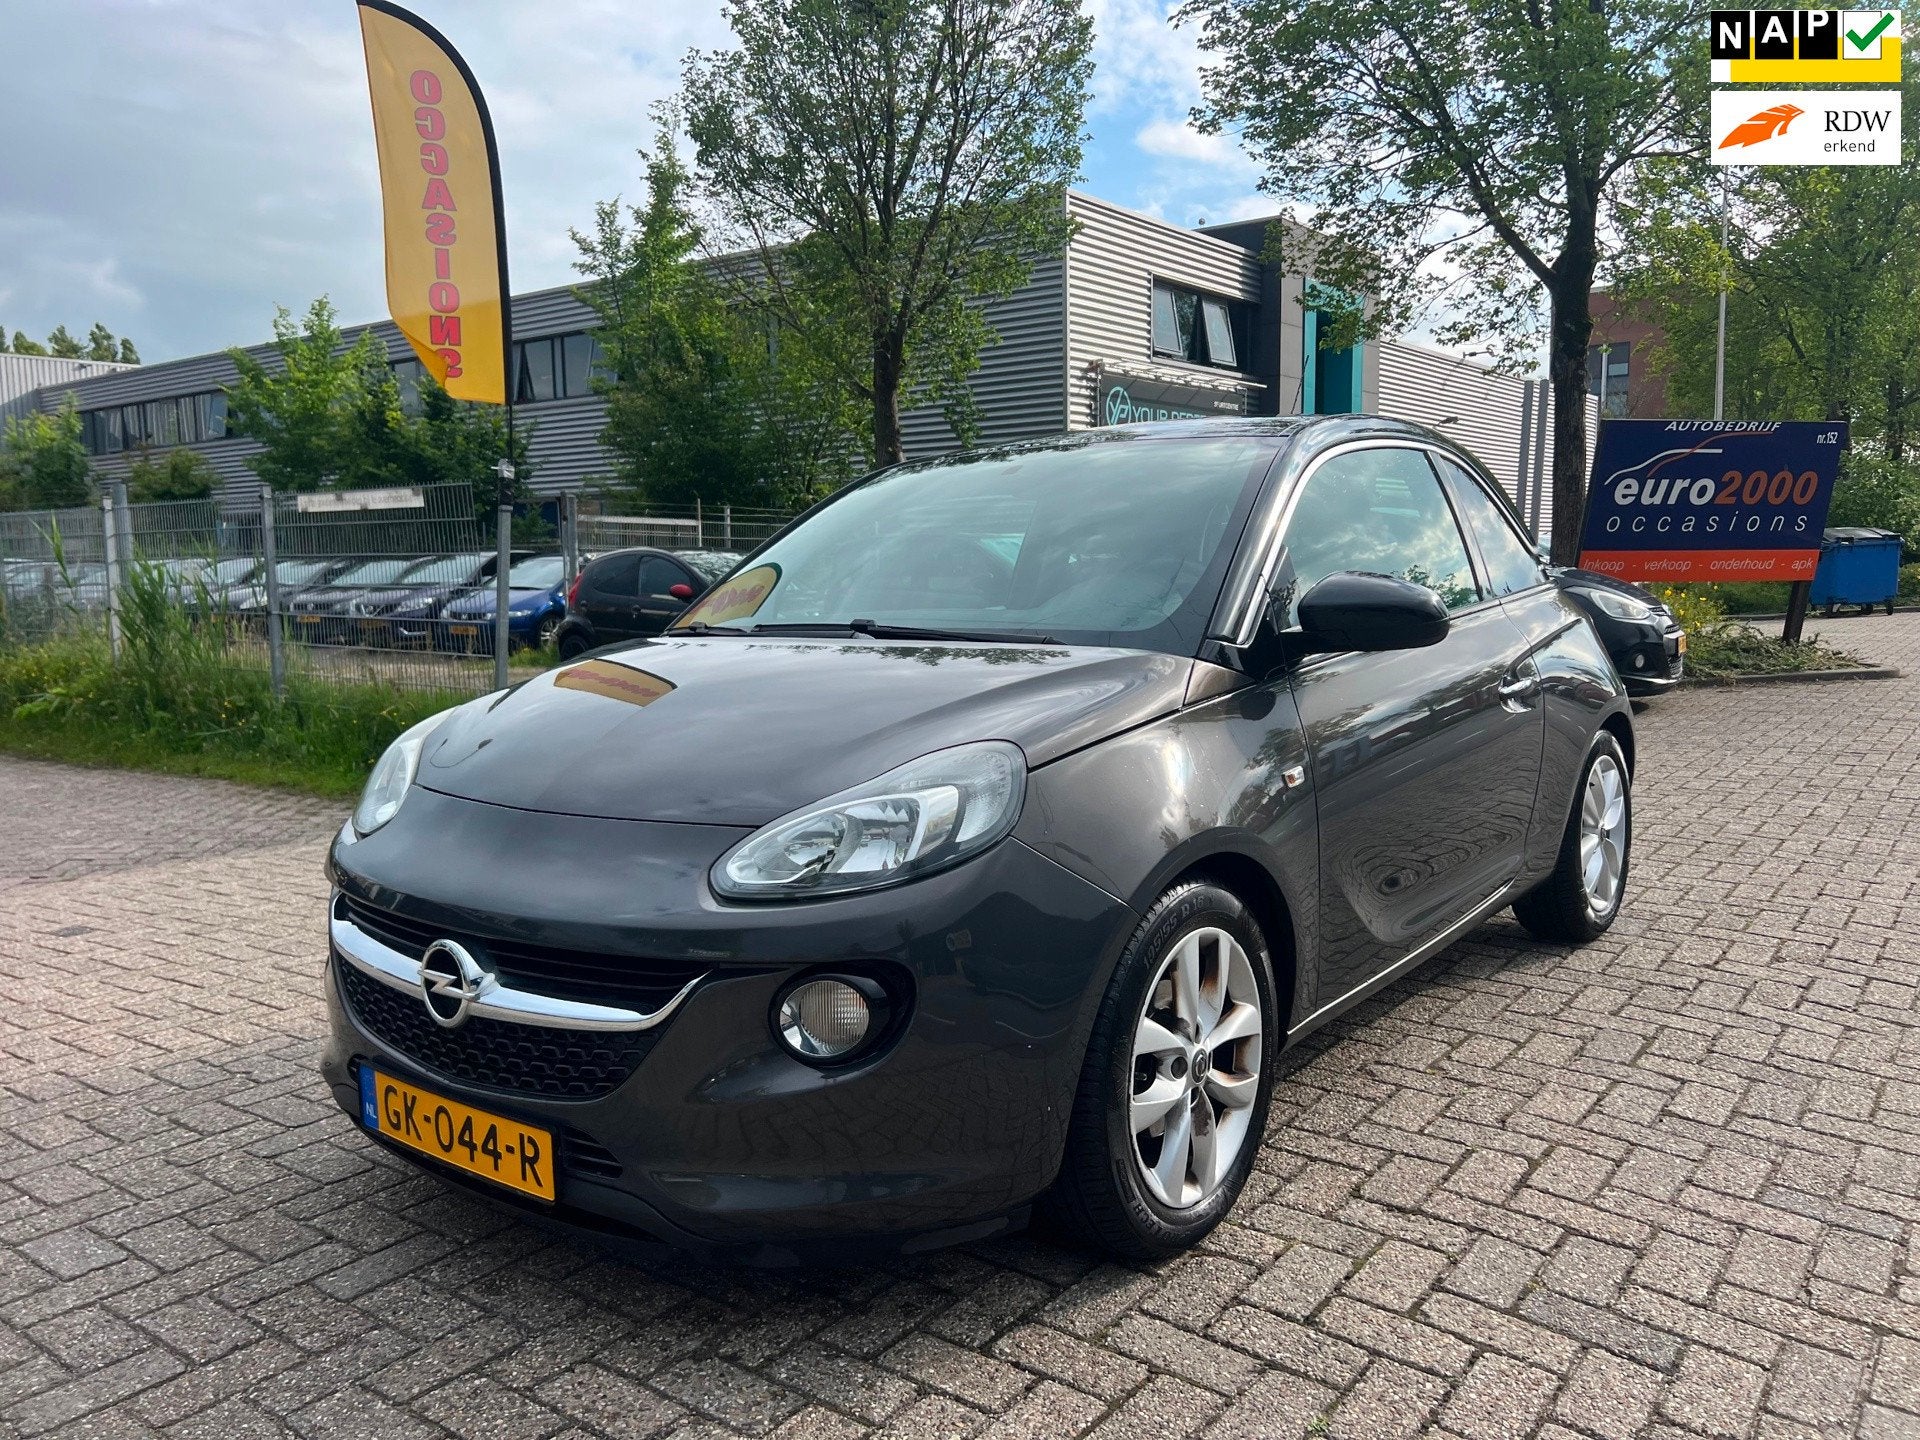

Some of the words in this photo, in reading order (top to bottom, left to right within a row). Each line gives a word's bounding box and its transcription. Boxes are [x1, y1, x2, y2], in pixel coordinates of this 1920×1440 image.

[1665, 421, 1782, 432] AUTOBEDRIJF
[1614, 470, 1819, 506] euro2000
[1606, 511, 1808, 532] occasions
[1643, 559, 1692, 571] verkoop
[1709, 557, 1775, 571] onderhoud
[1791, 557, 1814, 571] apk
[365, 1102, 378, 1119] NL
[384, 1084, 544, 1188] GK-044-R
